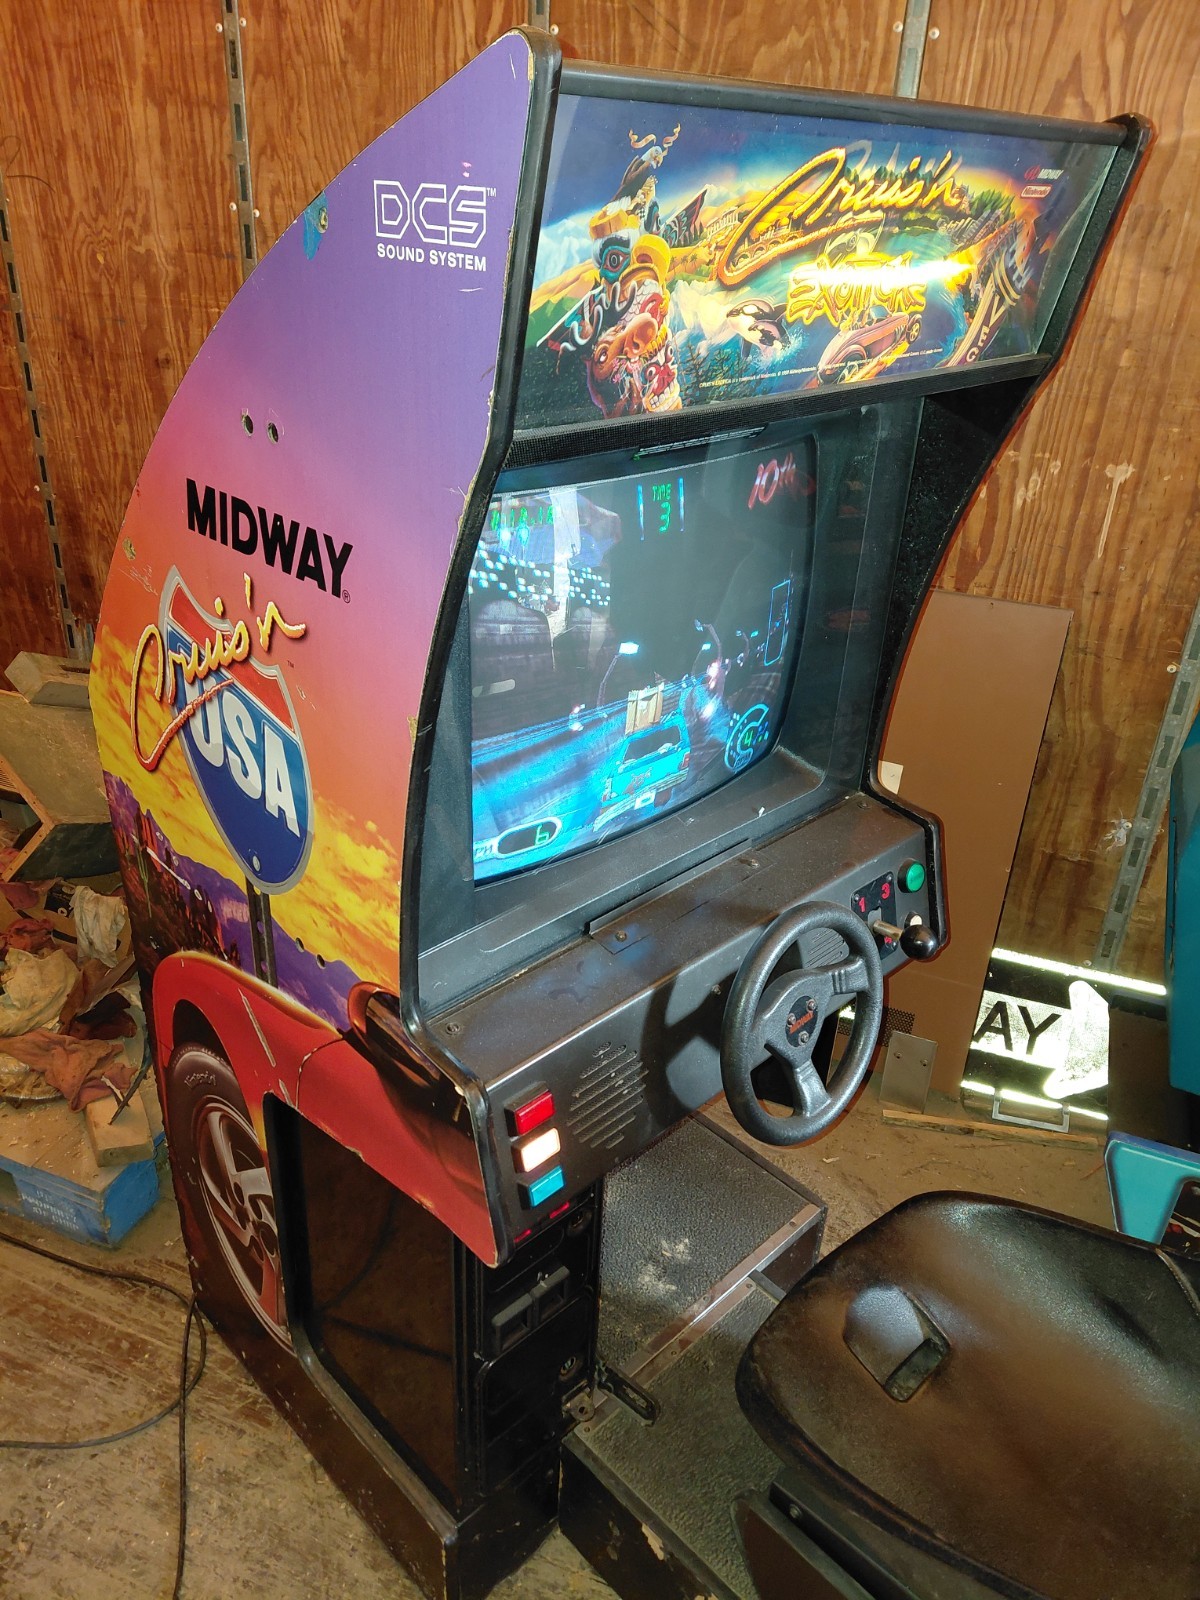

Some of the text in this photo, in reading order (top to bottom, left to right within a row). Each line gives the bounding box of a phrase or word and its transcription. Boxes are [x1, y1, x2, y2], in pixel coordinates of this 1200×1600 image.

[374, 180, 486, 248] DCS
[377, 243, 487, 271] SOUND SYSTEM
[652, 483, 672, 501] TIME
[659, 501, 671, 532] 3
[186, 477, 354, 599] MIDWAY
[131, 572, 305, 771] Cruis'n
[184, 677, 300, 838] USA
[859, 897, 866, 913] 1
[881, 882, 891, 900] 3
